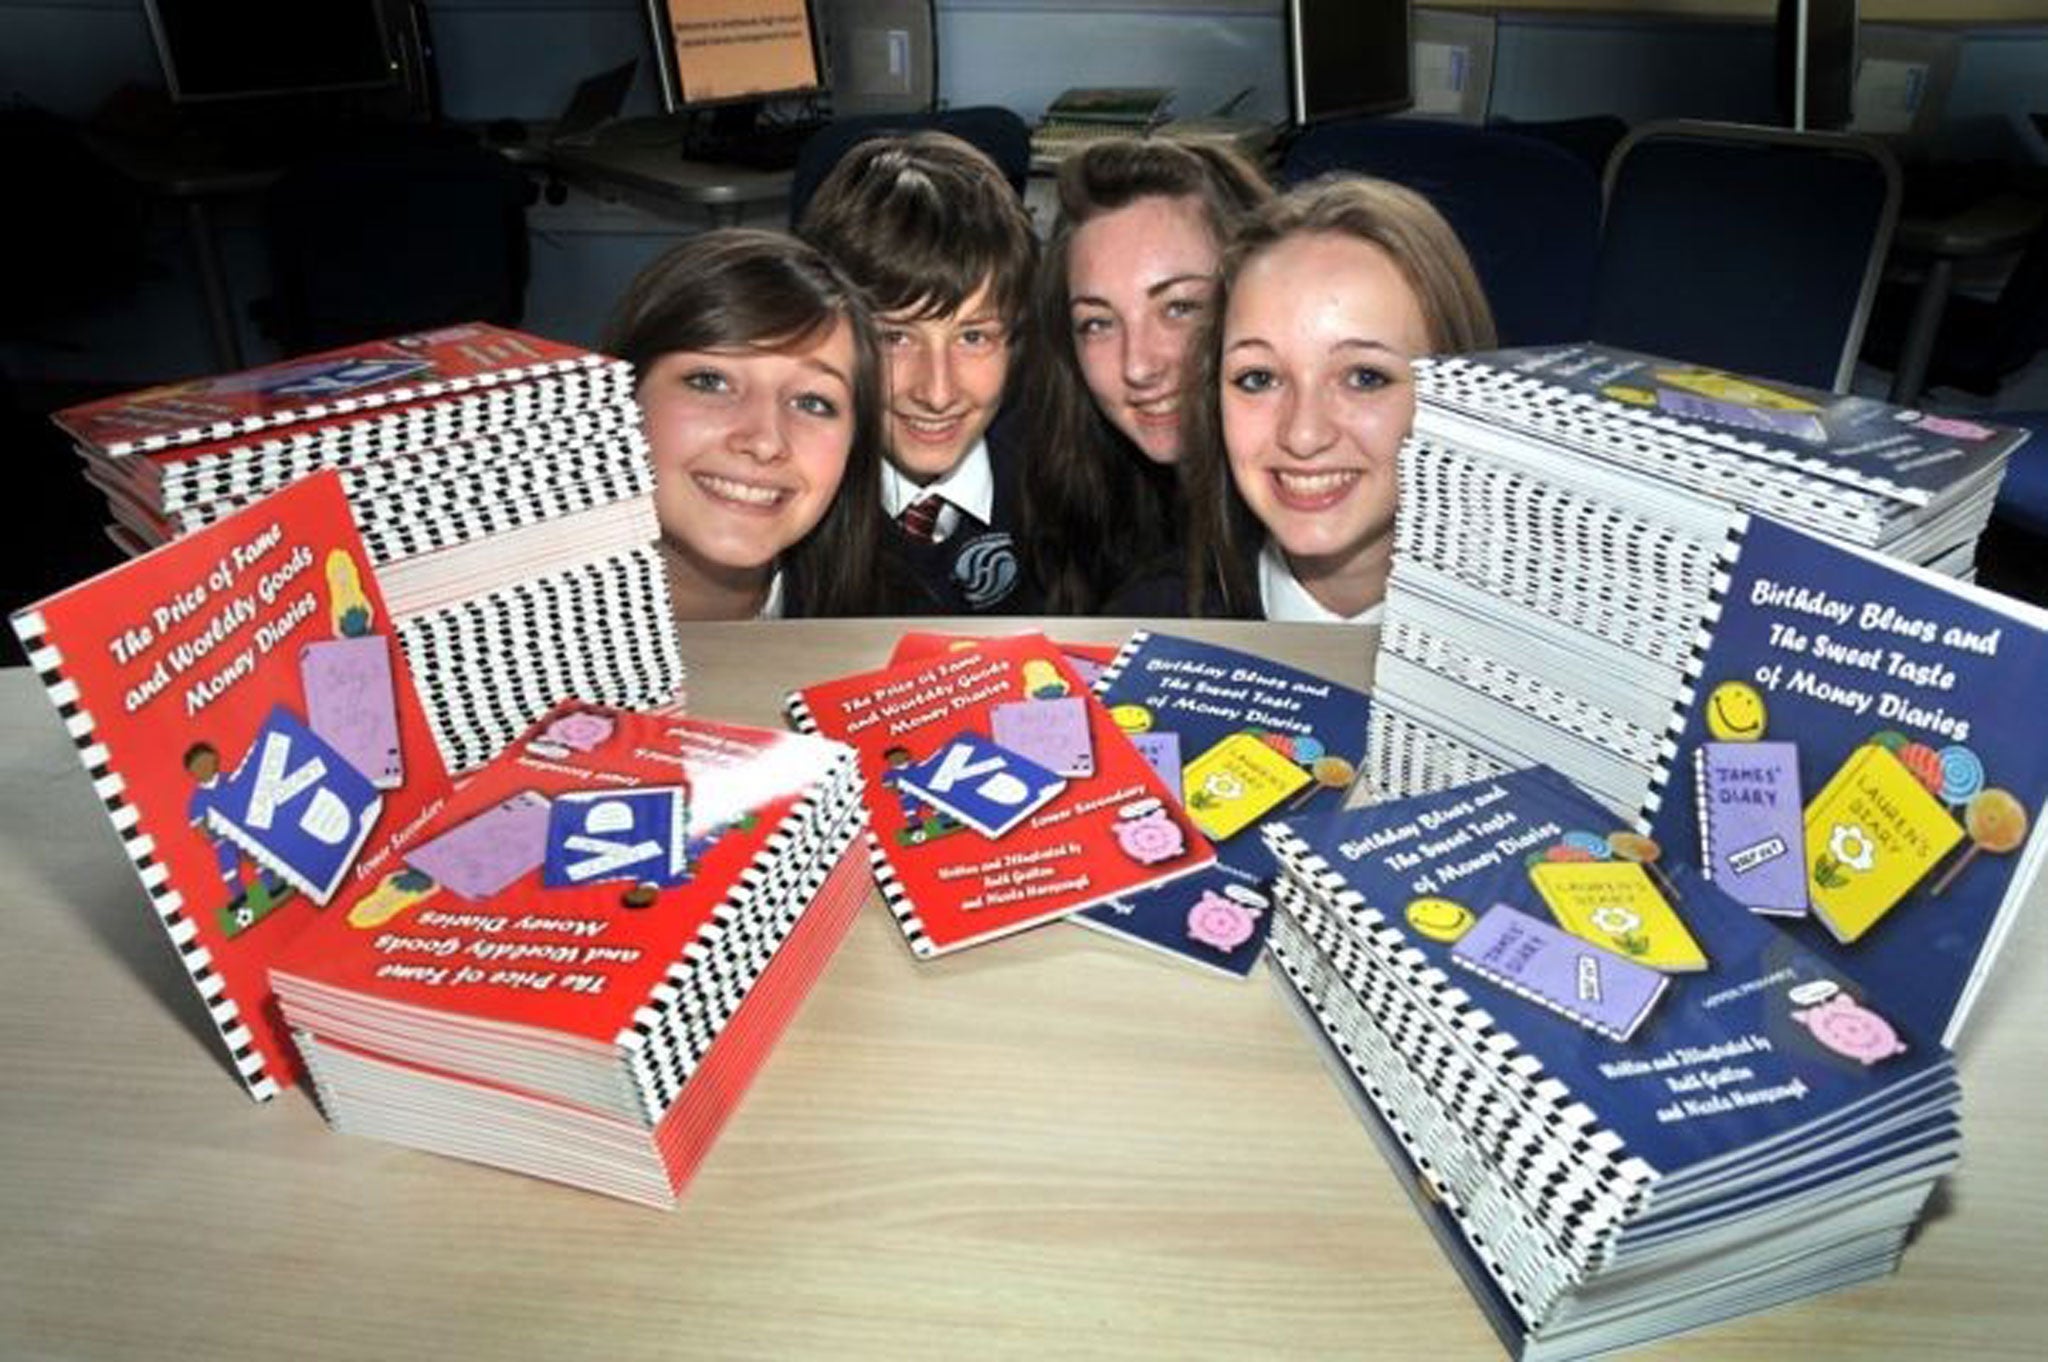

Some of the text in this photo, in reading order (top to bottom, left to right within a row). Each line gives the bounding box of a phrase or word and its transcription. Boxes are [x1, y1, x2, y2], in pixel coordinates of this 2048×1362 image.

[109, 523, 282, 665] The Price of Fame
[1750, 578, 2002, 656] Birthday Blues and
[125, 545, 314, 711] and Worldly Goods
[184, 592, 317, 715] Money Diaries
[1768, 623, 1957, 690] The Sweet Taste
[842, 654, 982, 713] The Price of Fame
[847, 660, 1009, 733] and Worldly Goods
[890, 680, 1009, 736] Money Diaries
[1146, 658, 1331, 698] Birthday Blues and
[1159, 677, 1302, 711] The Sweet Taste
[1755, 665, 1970, 742] of Money Diaries
[1145, 694, 1313, 734] of Money Diaries
[1338, 784, 1510, 861] Birthday Blues and
[1383, 811, 1518, 872] The Sweet Taste
[1412, 821, 1562, 894] of Money Diaries
[374, 933, 641, 964] and Worldly Goods
[416, 909, 610, 937] Money Diaries
[376, 963, 608, 994] The Price of Fame
